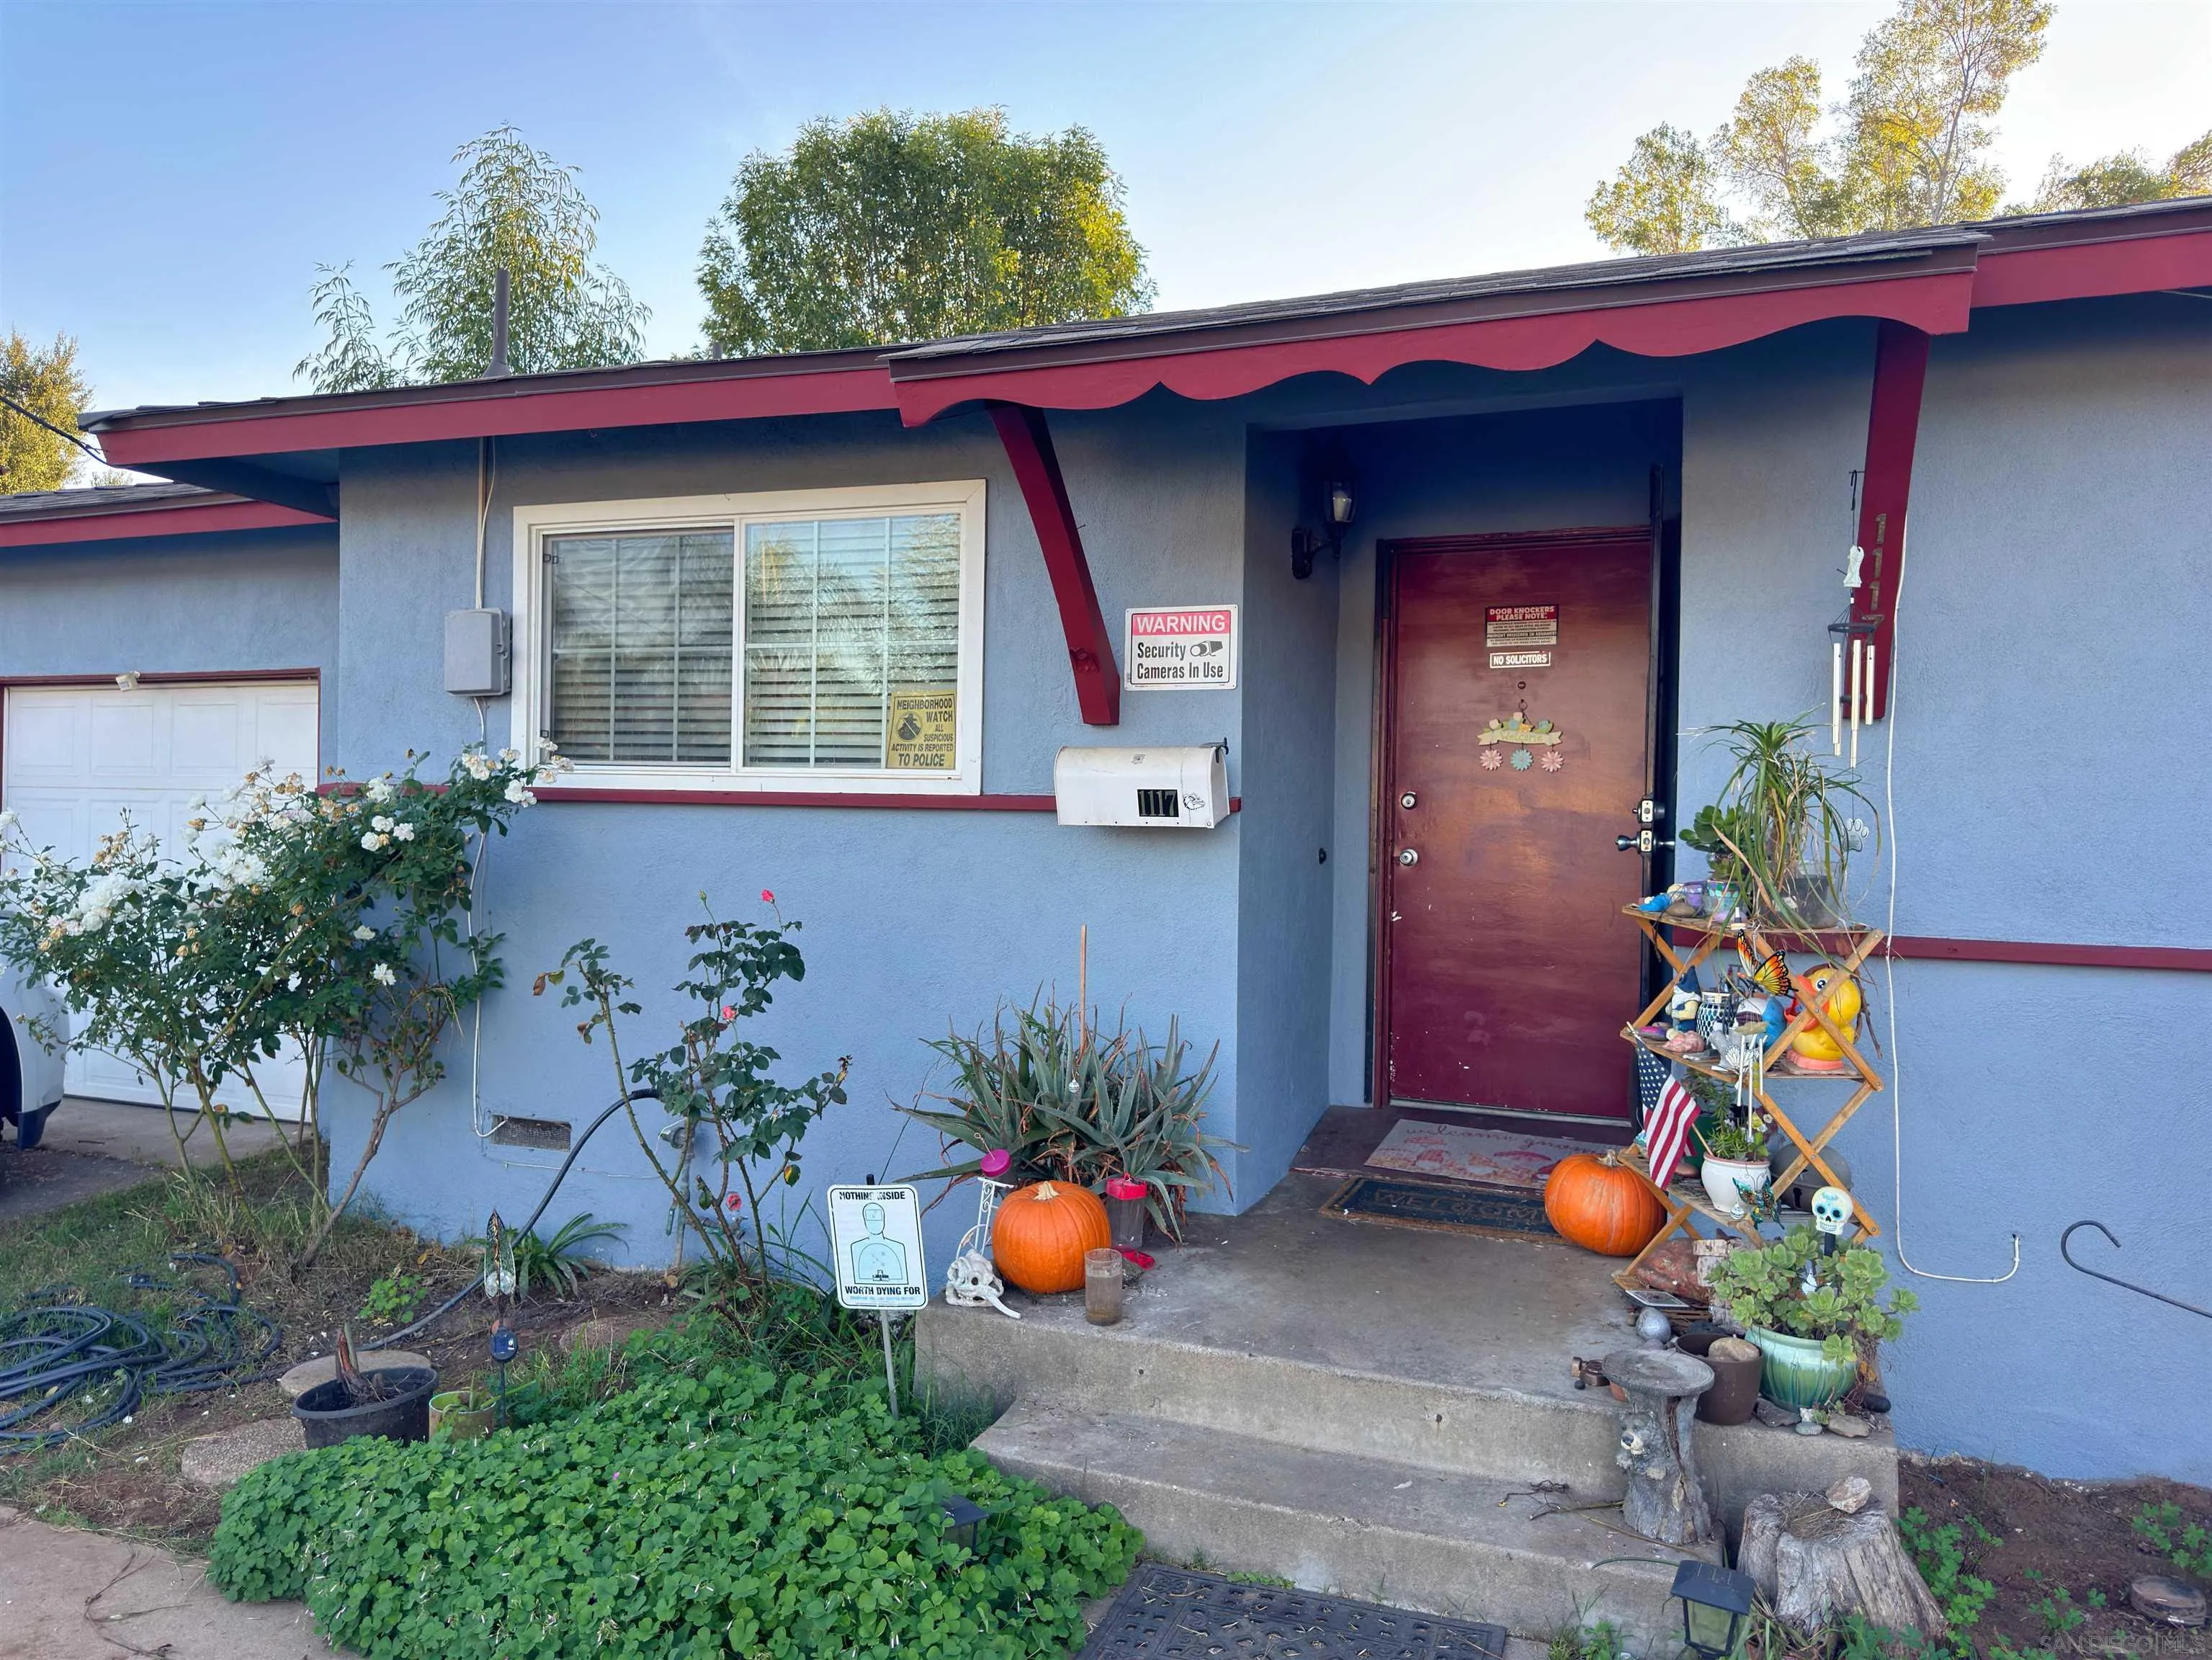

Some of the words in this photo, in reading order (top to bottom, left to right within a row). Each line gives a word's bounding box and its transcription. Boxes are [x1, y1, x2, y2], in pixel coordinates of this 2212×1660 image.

[1136, 615, 1225, 633] WARNING
[1137, 641, 1186, 661] Security
[1493, 656, 1505, 666] NO
[1505, 653, 1548, 665] SOLICITORS
[1137, 663, 1185, 679] Cameras
[1188, 662, 1199, 679] In
[1203, 661, 1224, 678] Use
[897, 697, 953, 710] NEIGHBORHOOD
[926, 710, 953, 723] WATCH
[923, 733, 954, 742] SUSPICIOUS
[898, 754, 910, 766] TO
[913, 754, 945, 767] POLICE
[1139, 790, 1177, 816] 1117
[845, 1285, 874, 1295] WORTH
[877, 1286, 901, 1295] DYING
[904, 1286, 921, 1295] FOR
